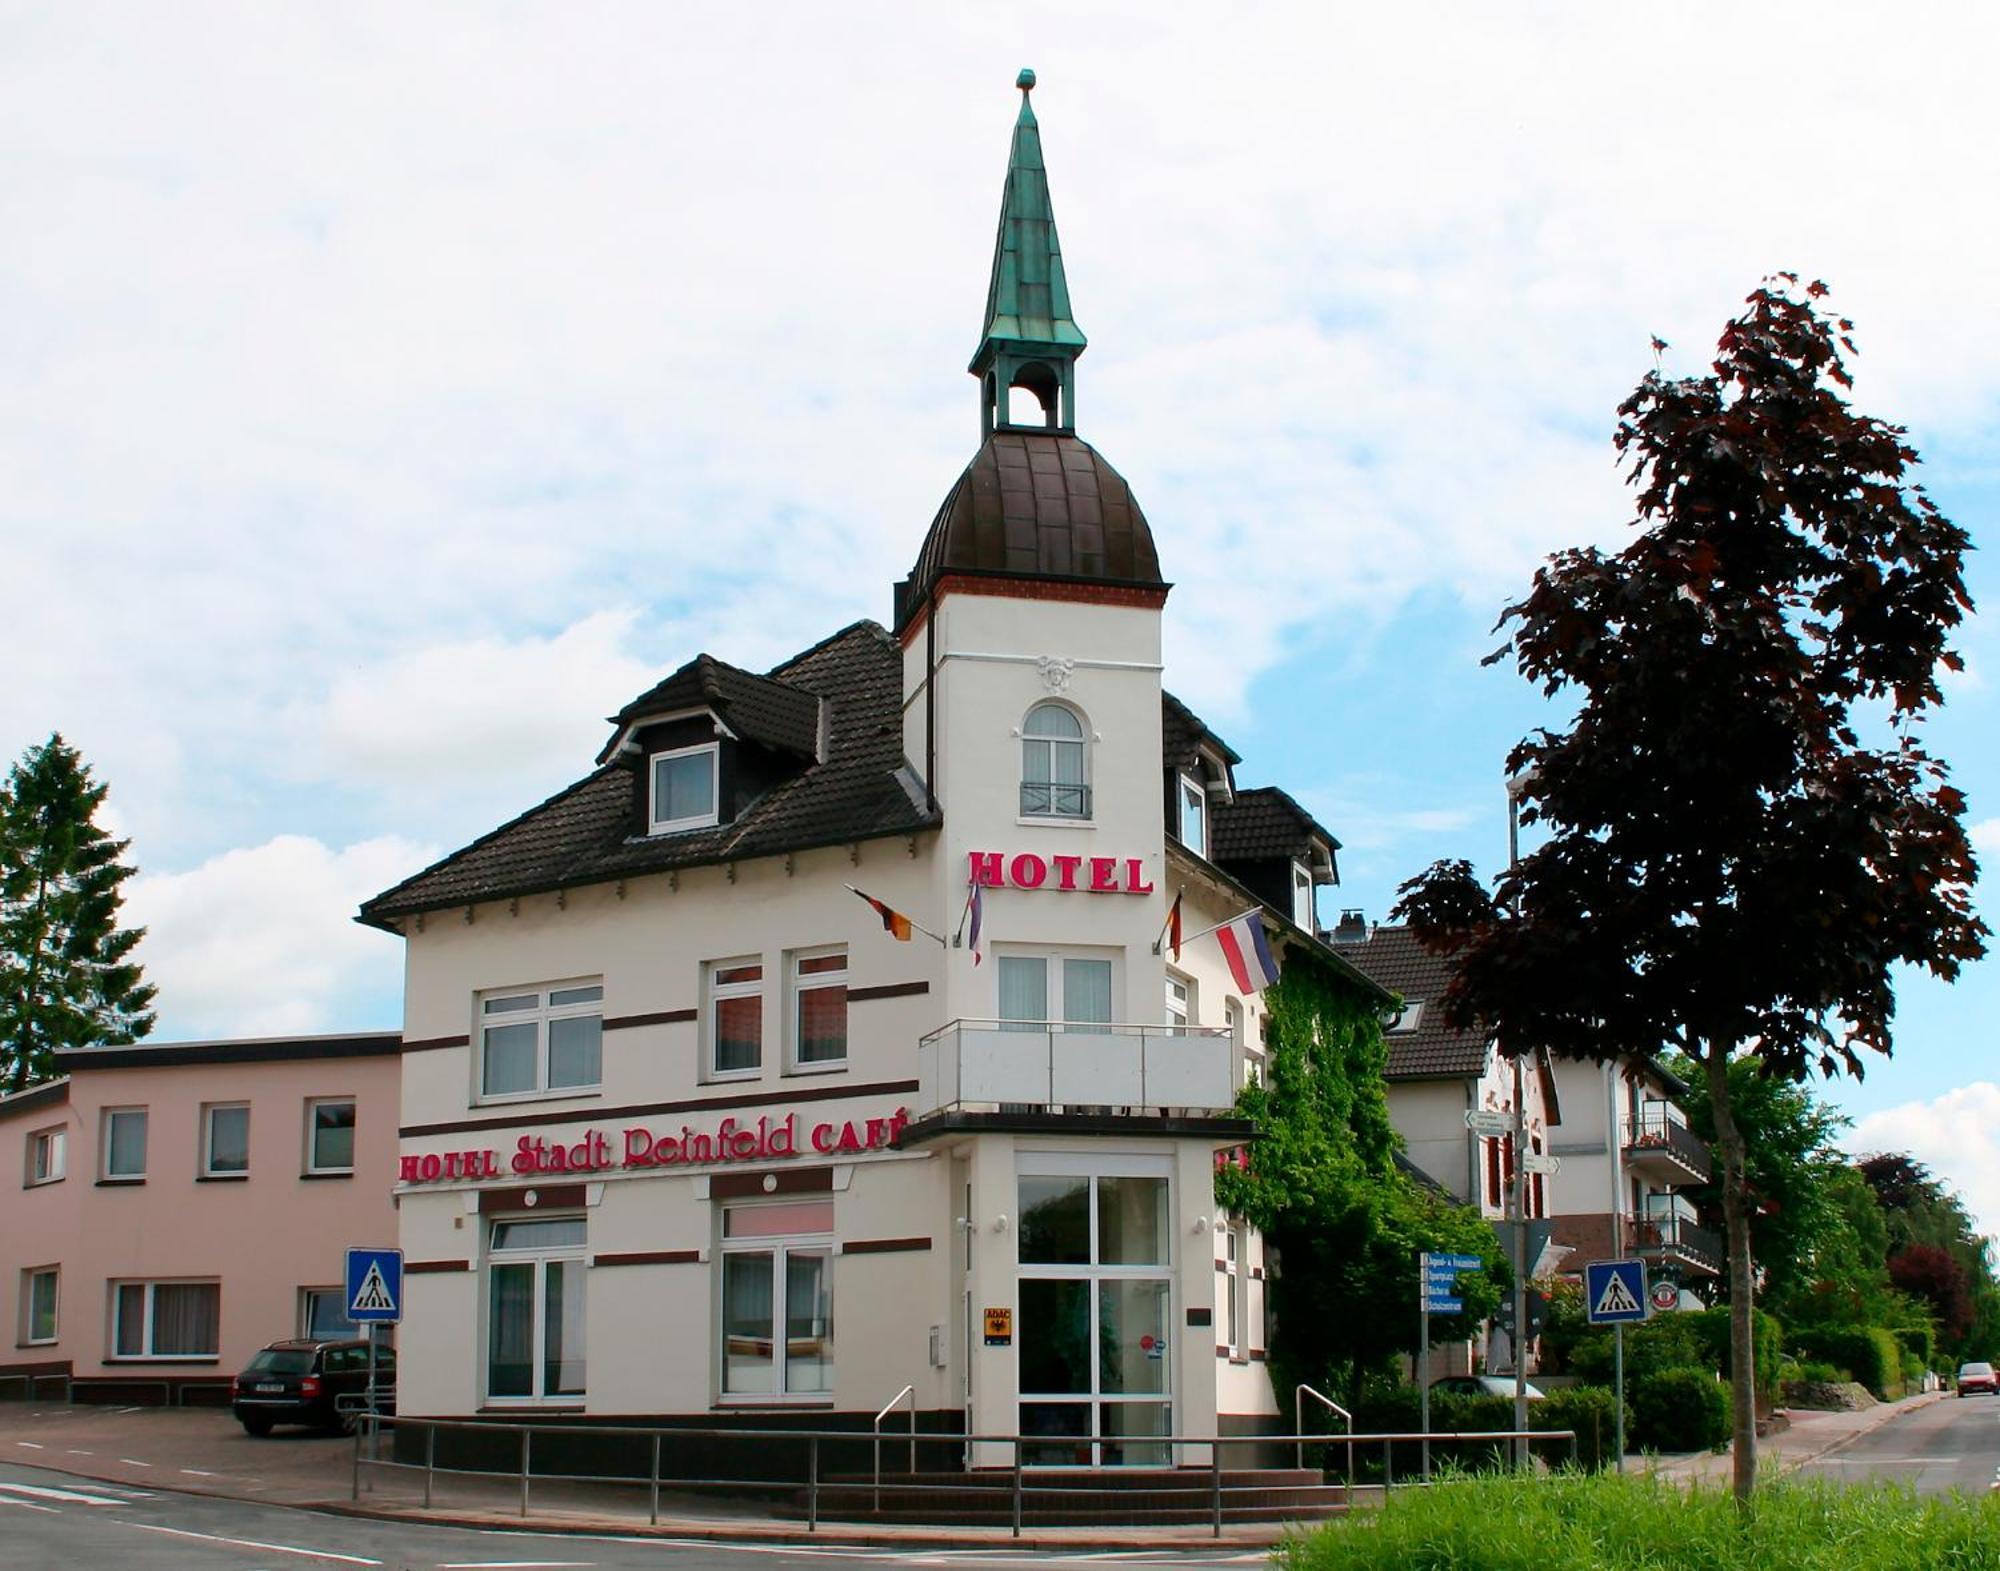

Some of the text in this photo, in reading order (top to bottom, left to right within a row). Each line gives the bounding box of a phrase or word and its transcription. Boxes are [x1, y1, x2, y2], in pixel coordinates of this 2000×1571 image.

[968, 851, 1154, 895] HOTEL
[399, 1150, 498, 1182] HOTEL
[511, 1128, 611, 1174] Stadt
[622, 1112, 796, 1169] Reinfeld
[985, 1309, 1010, 1318] ADAC
